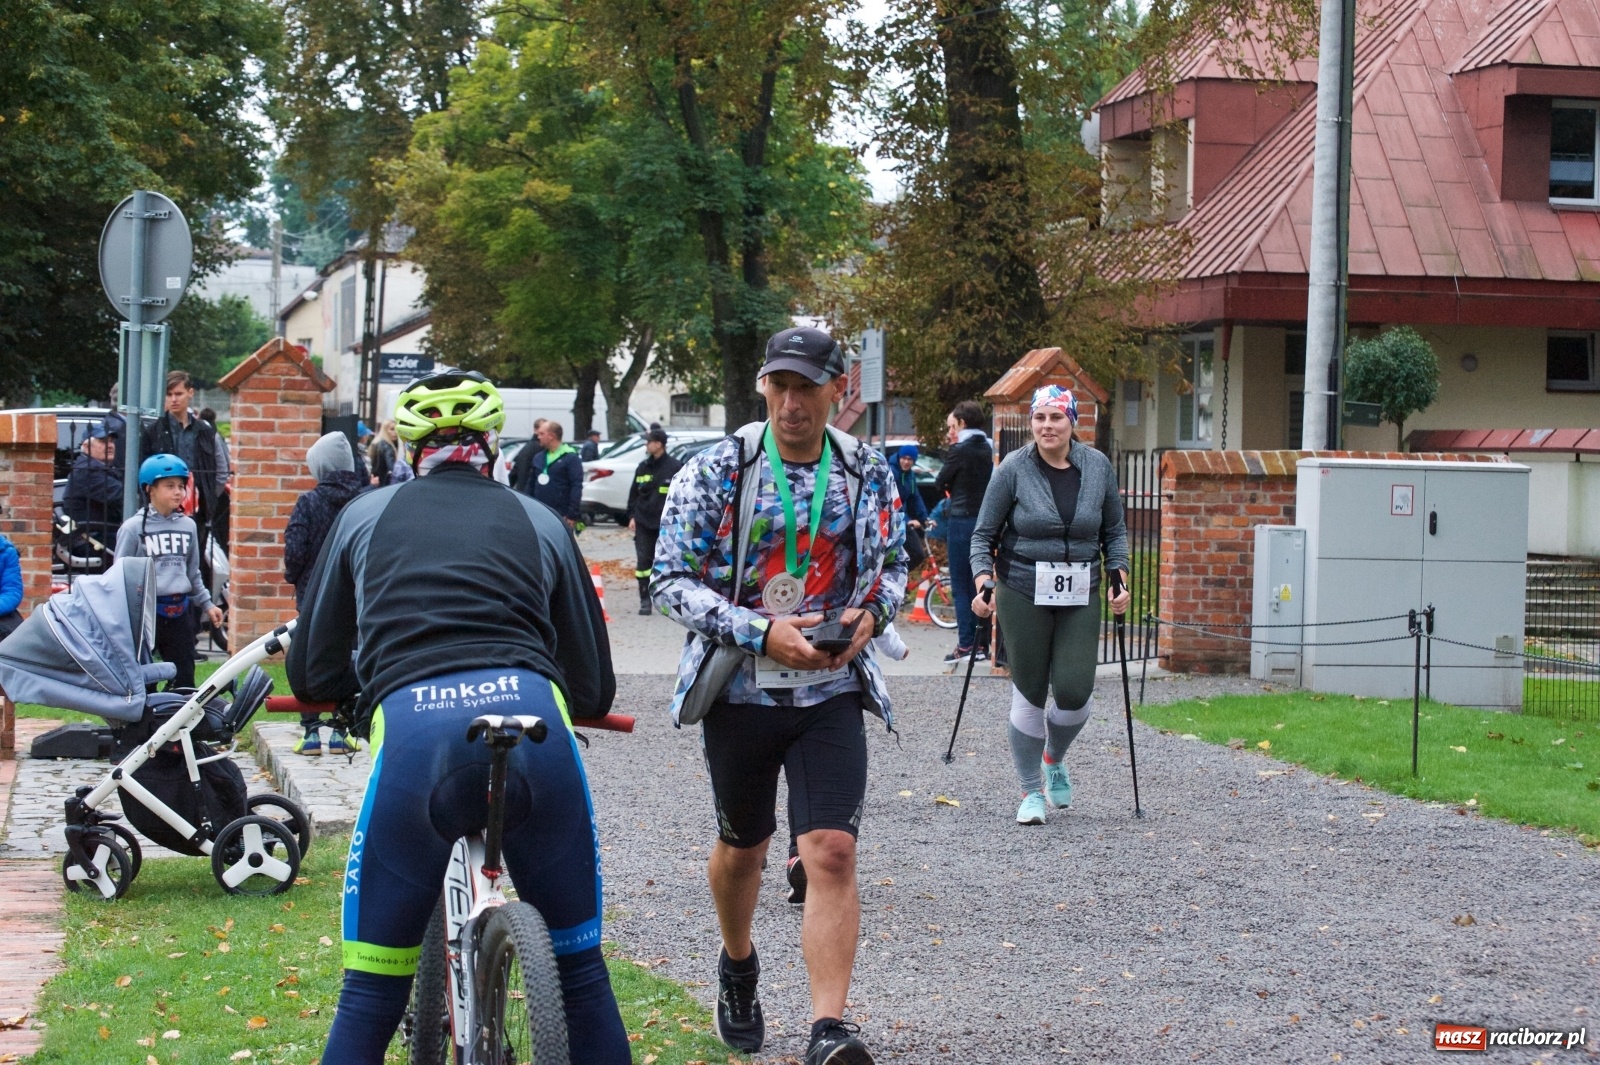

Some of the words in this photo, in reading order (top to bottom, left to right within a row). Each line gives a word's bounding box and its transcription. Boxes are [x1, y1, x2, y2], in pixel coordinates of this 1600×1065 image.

[145, 533, 190, 557] NEFF
[1054, 574, 1073, 593] 81
[411, 675, 520, 702] Tinkoff
[414, 700, 456, 712] Credit
[463, 693, 521, 708] Systems
[346, 830, 364, 895] SAXO
